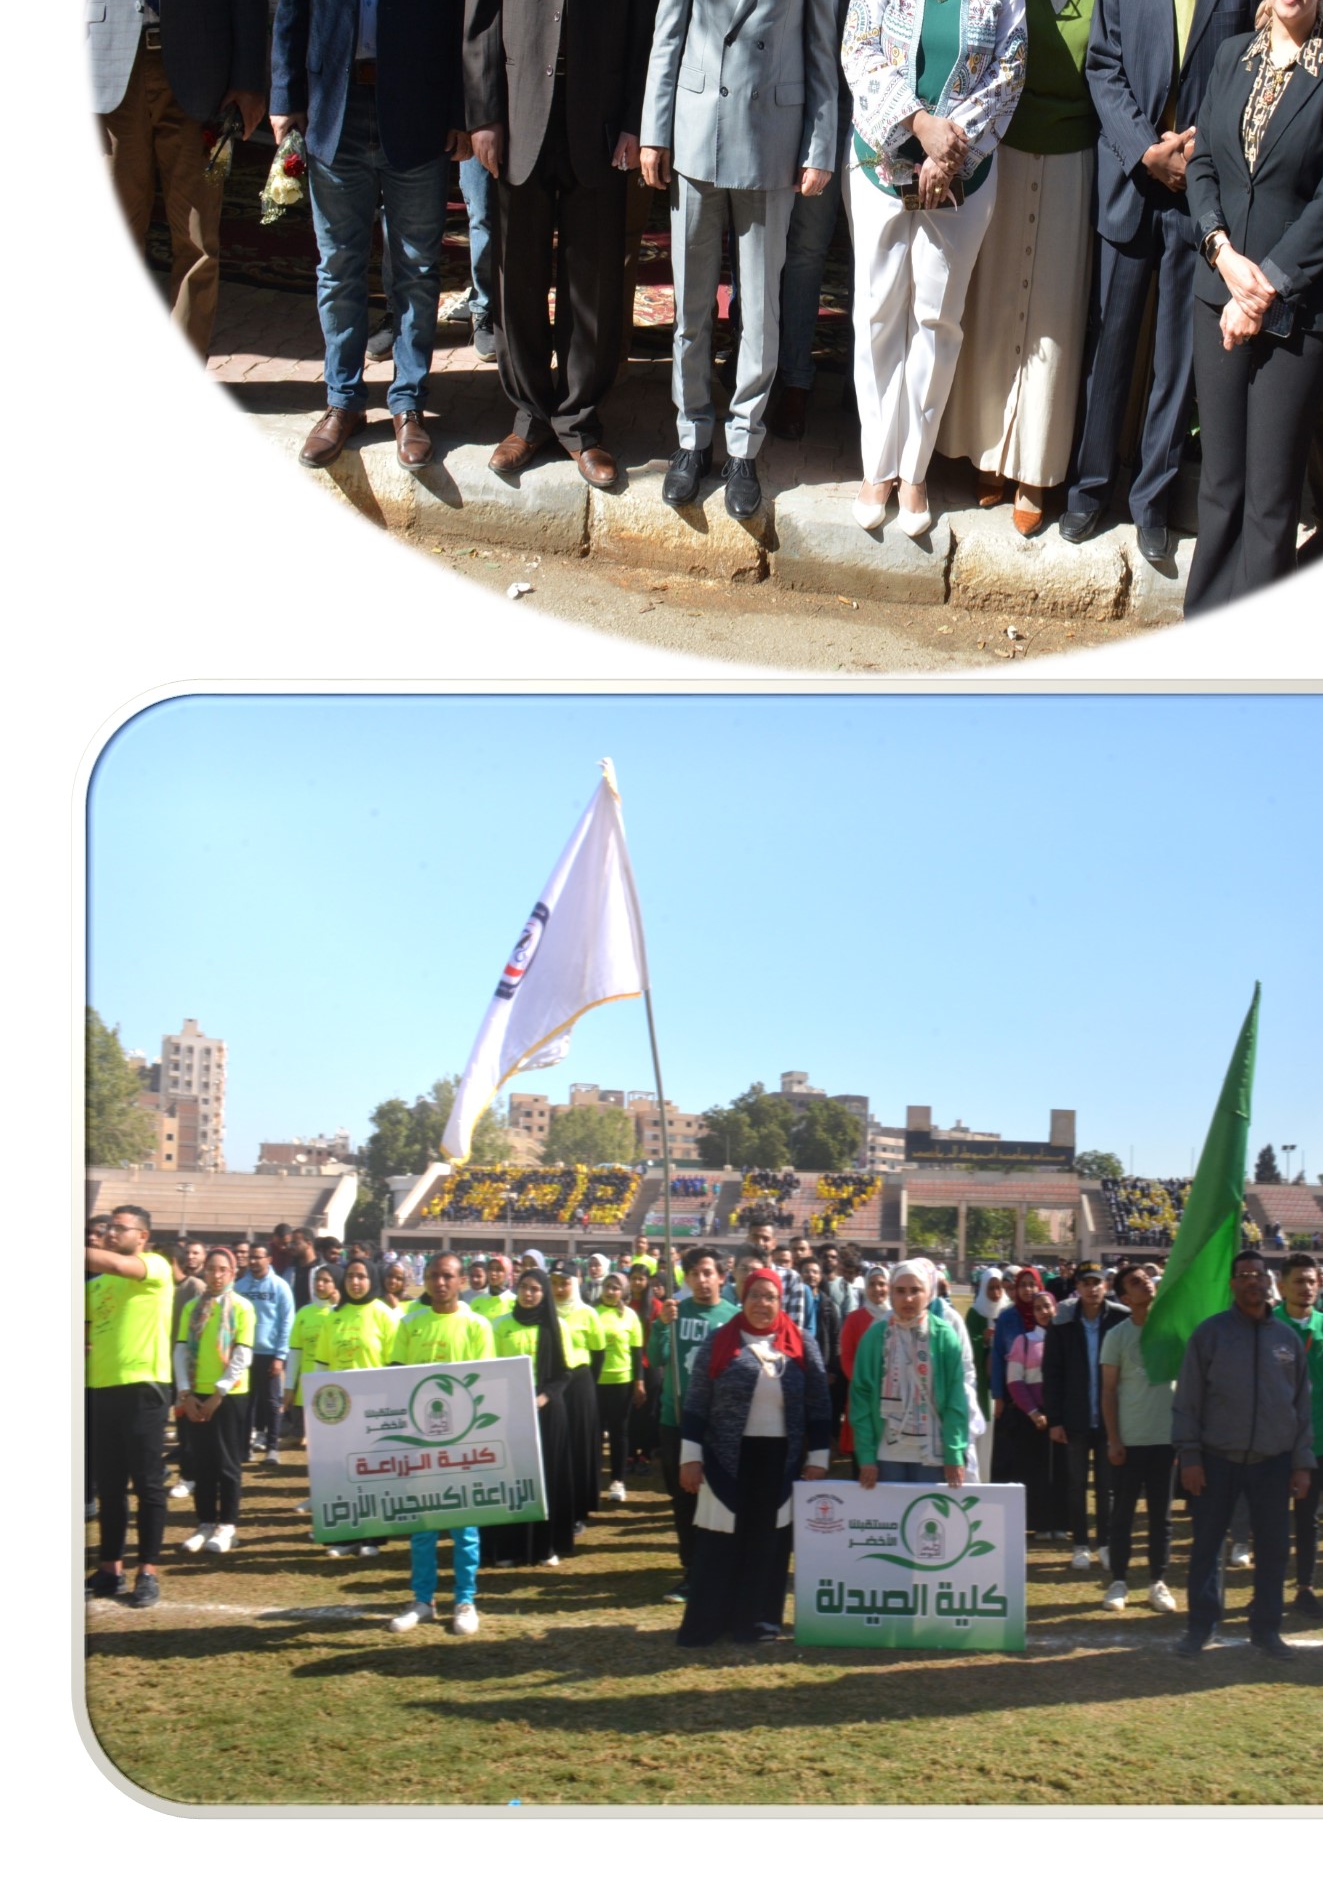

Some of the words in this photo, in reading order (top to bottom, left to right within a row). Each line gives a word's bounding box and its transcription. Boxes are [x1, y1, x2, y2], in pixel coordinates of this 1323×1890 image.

[355, 1453, 431, 1477] الزراعة
[438, 1446, 497, 1471] كلية
[322, 1485, 377, 1529] الأرض
[380, 1484, 468, 1522] اكسجين
[471, 1478, 535, 1512] الزراعة
[816, 1578, 928, 1625] الصيدلة
[935, 1581, 1008, 1627] كلية
